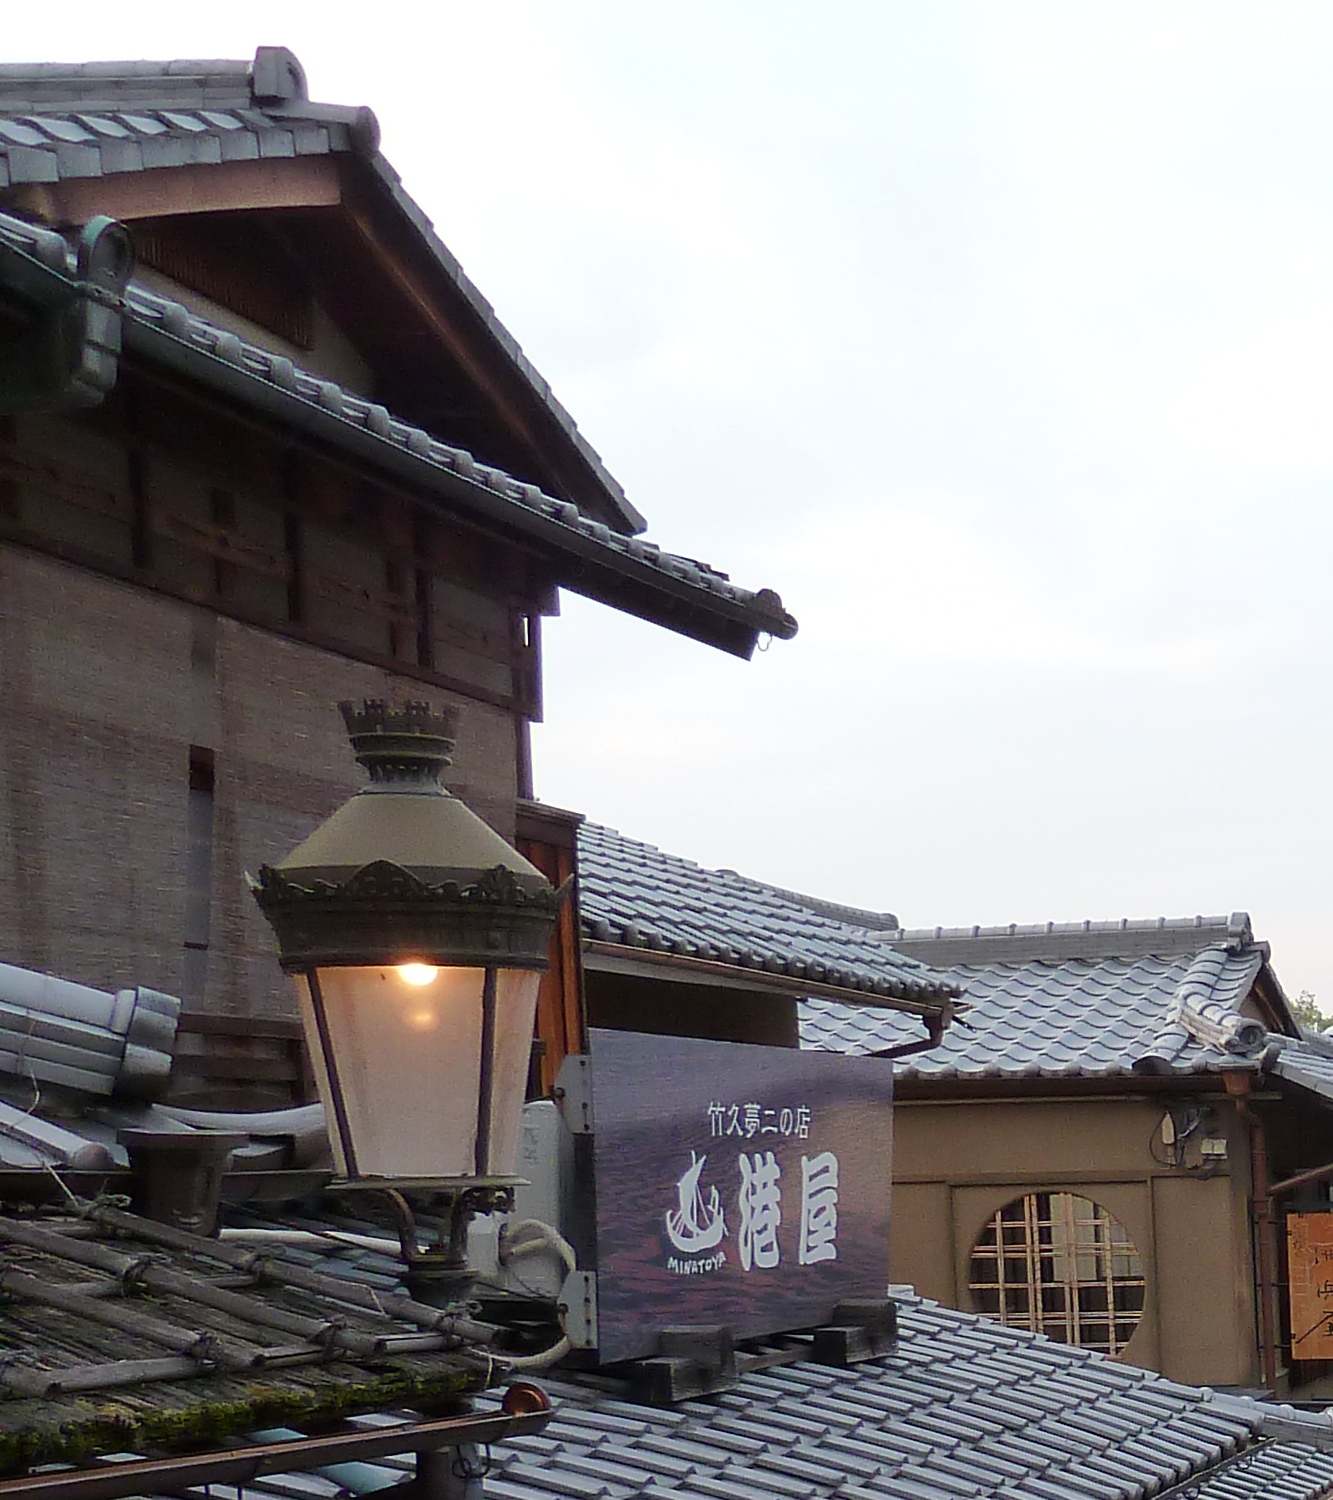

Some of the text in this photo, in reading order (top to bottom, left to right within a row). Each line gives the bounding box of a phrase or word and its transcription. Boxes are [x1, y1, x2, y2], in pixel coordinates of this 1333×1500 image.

[708, 1101, 812, 1140] 竹久夢二の店
[738, 1150, 840, 1271] 港屋
[667, 1252, 729, 1276] MINATOYA
